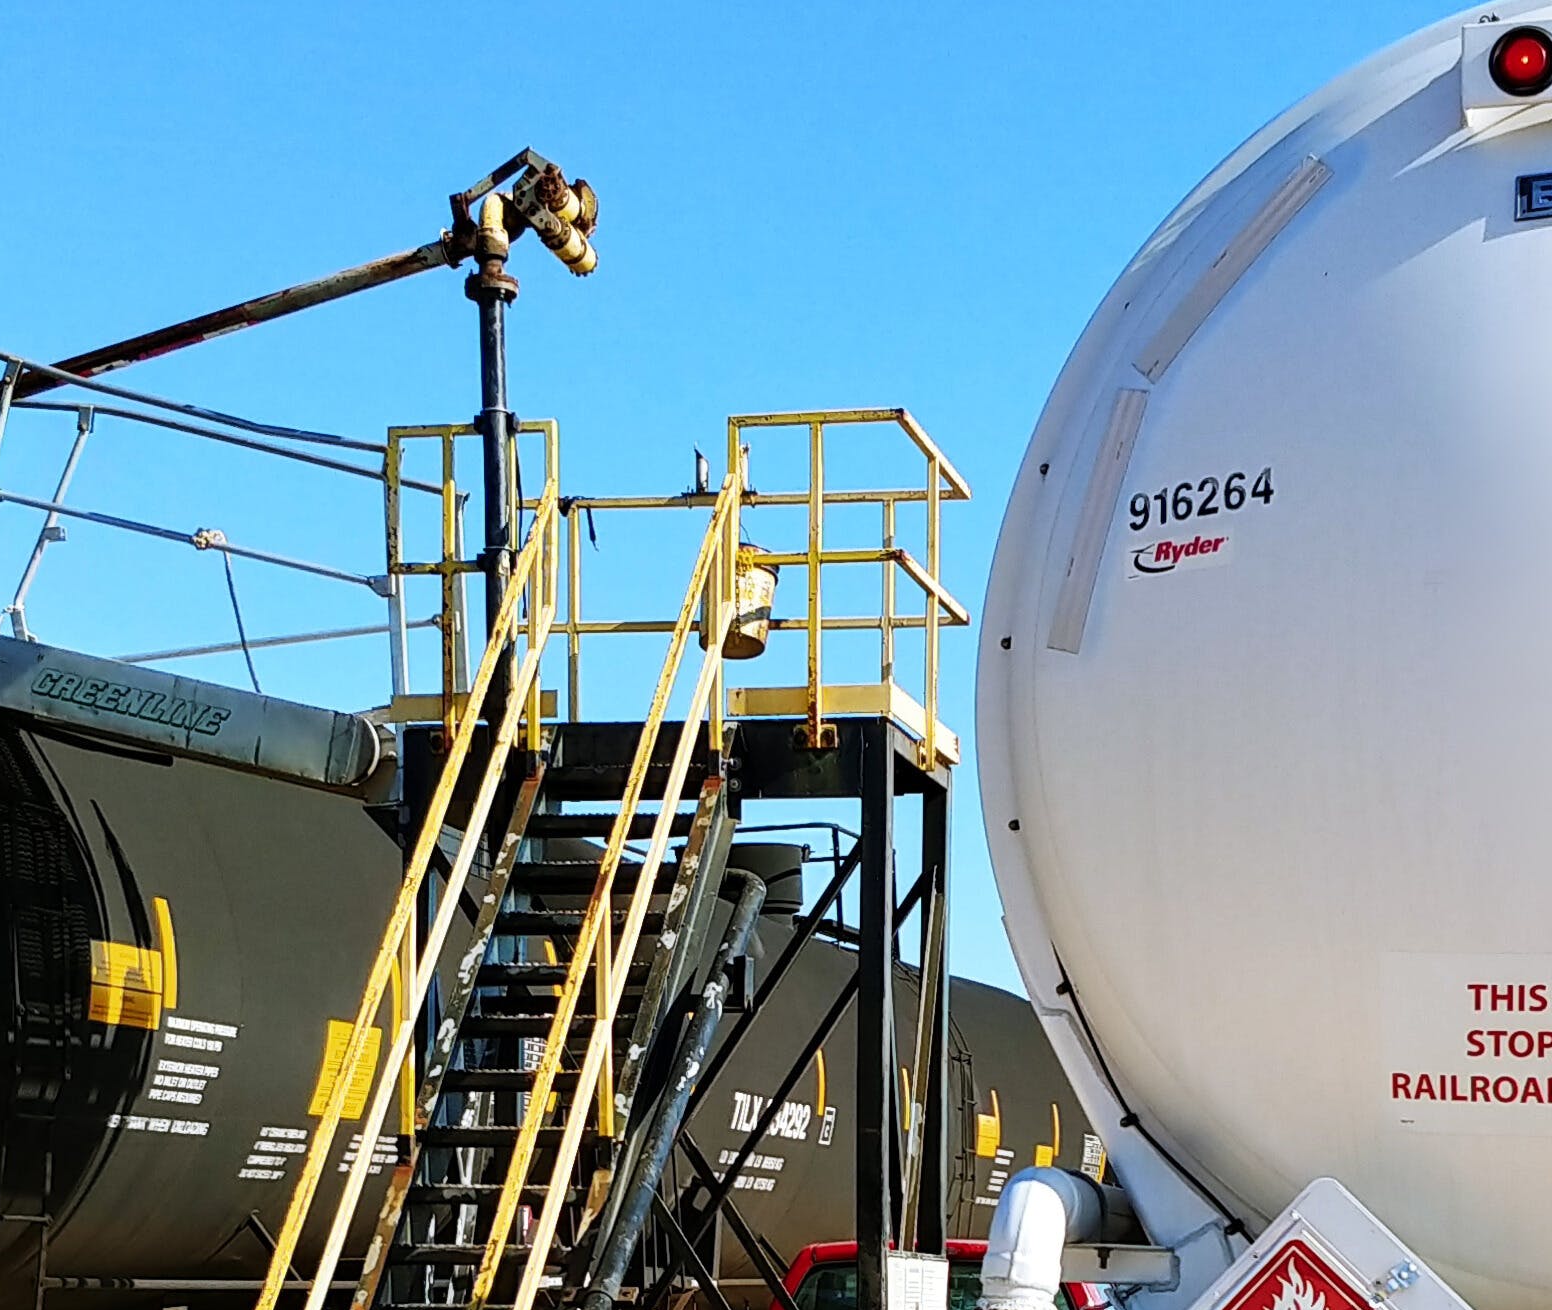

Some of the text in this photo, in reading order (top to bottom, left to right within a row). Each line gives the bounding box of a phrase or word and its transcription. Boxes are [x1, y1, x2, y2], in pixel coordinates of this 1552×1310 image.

[1129, 467, 1274, 531] 916264
[1154, 536, 1225, 564] Ryder
[31, 667, 232, 736] GREENLINE
[1467, 983, 1548, 1012] THIS
[730, 1091, 764, 1133] TILX
